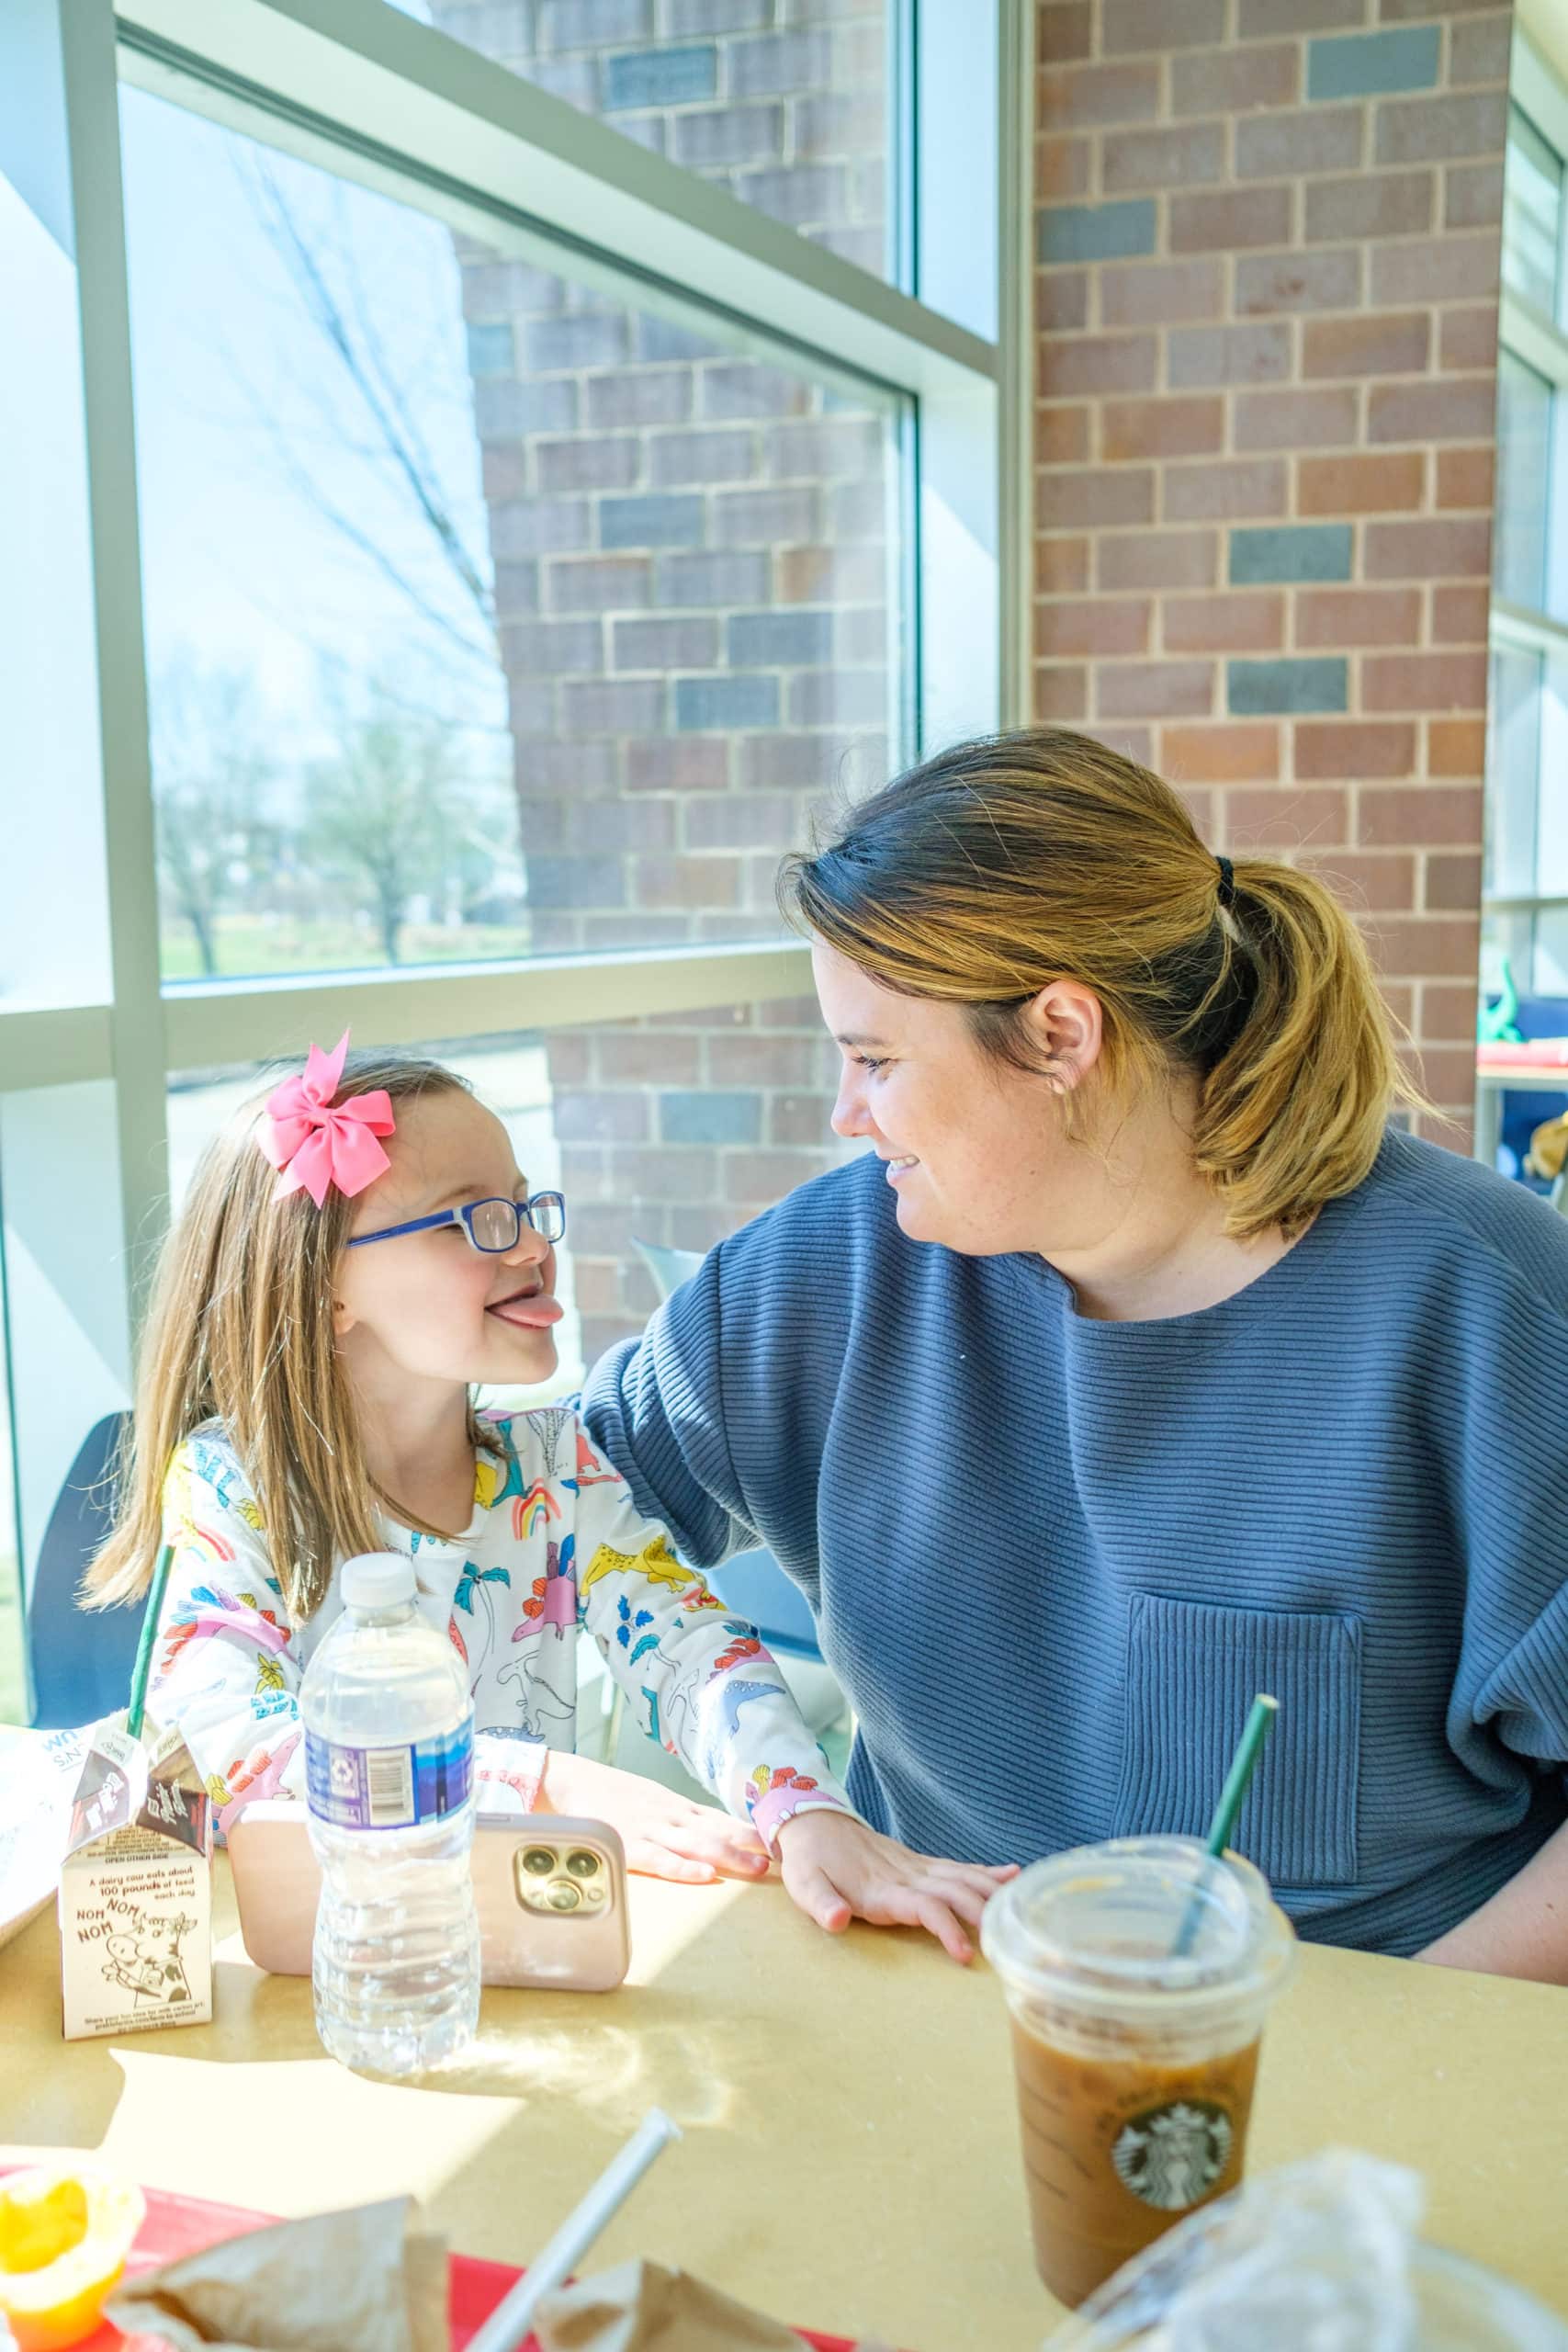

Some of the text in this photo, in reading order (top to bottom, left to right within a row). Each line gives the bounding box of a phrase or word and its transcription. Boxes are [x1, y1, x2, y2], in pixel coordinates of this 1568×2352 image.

[99, 1875, 123, 1885] dairy
[147, 1869, 165, 1879] eats
[168, 1866, 193, 1876] about
[101, 1886, 118, 1896] 100
[122, 1882, 161, 1896] pounds
[176, 1877, 195, 1886] feed
[154, 1888, 196, 1900] each day
[77, 1909, 105, 1919] NOM
[107, 1898, 140, 1917] NOM
[77, 1921, 113, 1942] NOM
